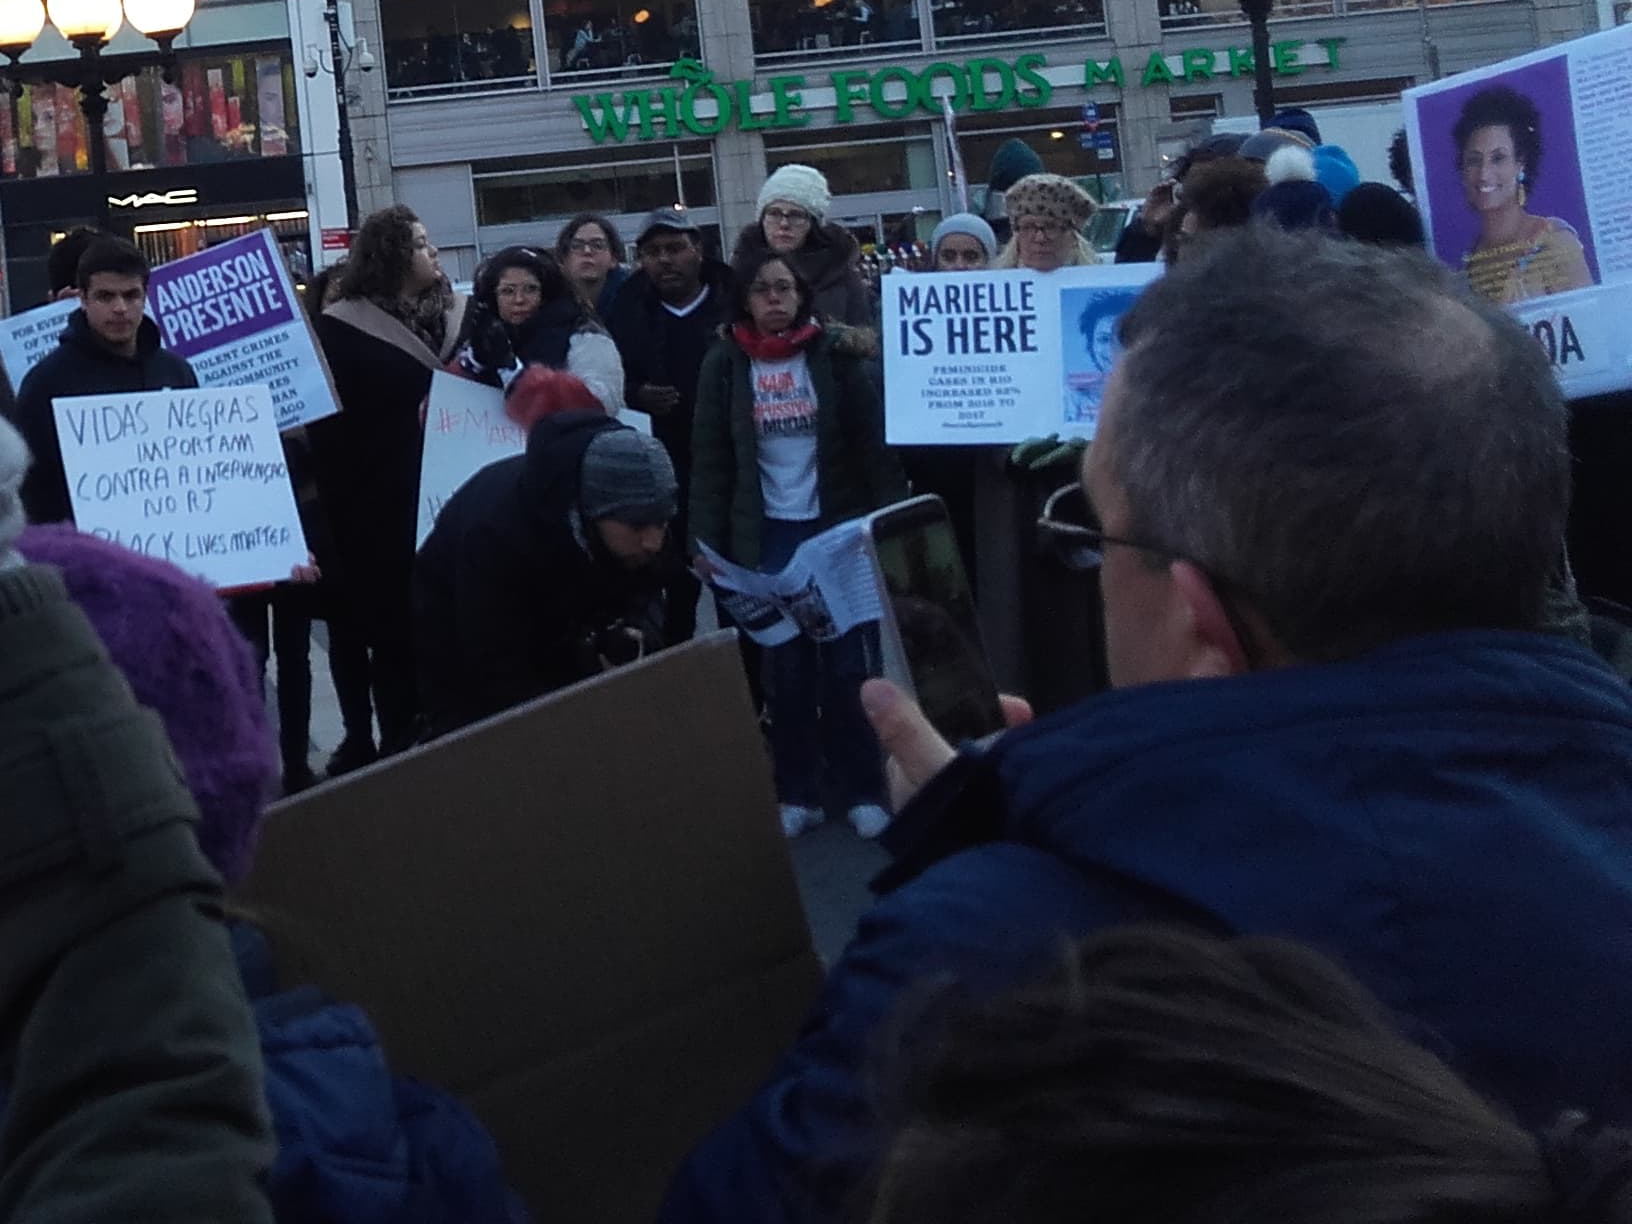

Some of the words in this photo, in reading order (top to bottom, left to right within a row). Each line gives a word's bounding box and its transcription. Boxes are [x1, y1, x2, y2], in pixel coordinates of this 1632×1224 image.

[570, 57, 811, 145] WHOLE
[831, 53, 1049, 124] FOODS
[1083, 36, 1347, 91] MARKET
[156, 249, 270, 315] ANDERSON
[898, 280, 1035, 316] MARIELLE
[162, 277, 282, 347] PRESENTE
[194, 349, 239, 371] IOLENT
[241, 331, 290, 354] CRIMES
[900, 318, 934, 356] IS
[946, 314, 1039, 355] HERE
[204, 358, 255, 383] AGAINST
[257, 348, 282, 365] THE
[66, 401, 148, 447] VIDAS
[168, 396, 259, 432] NEGRAS
[137, 433, 255, 463] IMPORTAM
[76, 466, 169, 502] CONTRA
[178, 466, 189, 485] A
[144, 496, 177, 518] NO
[187, 488, 217, 514] RJ
